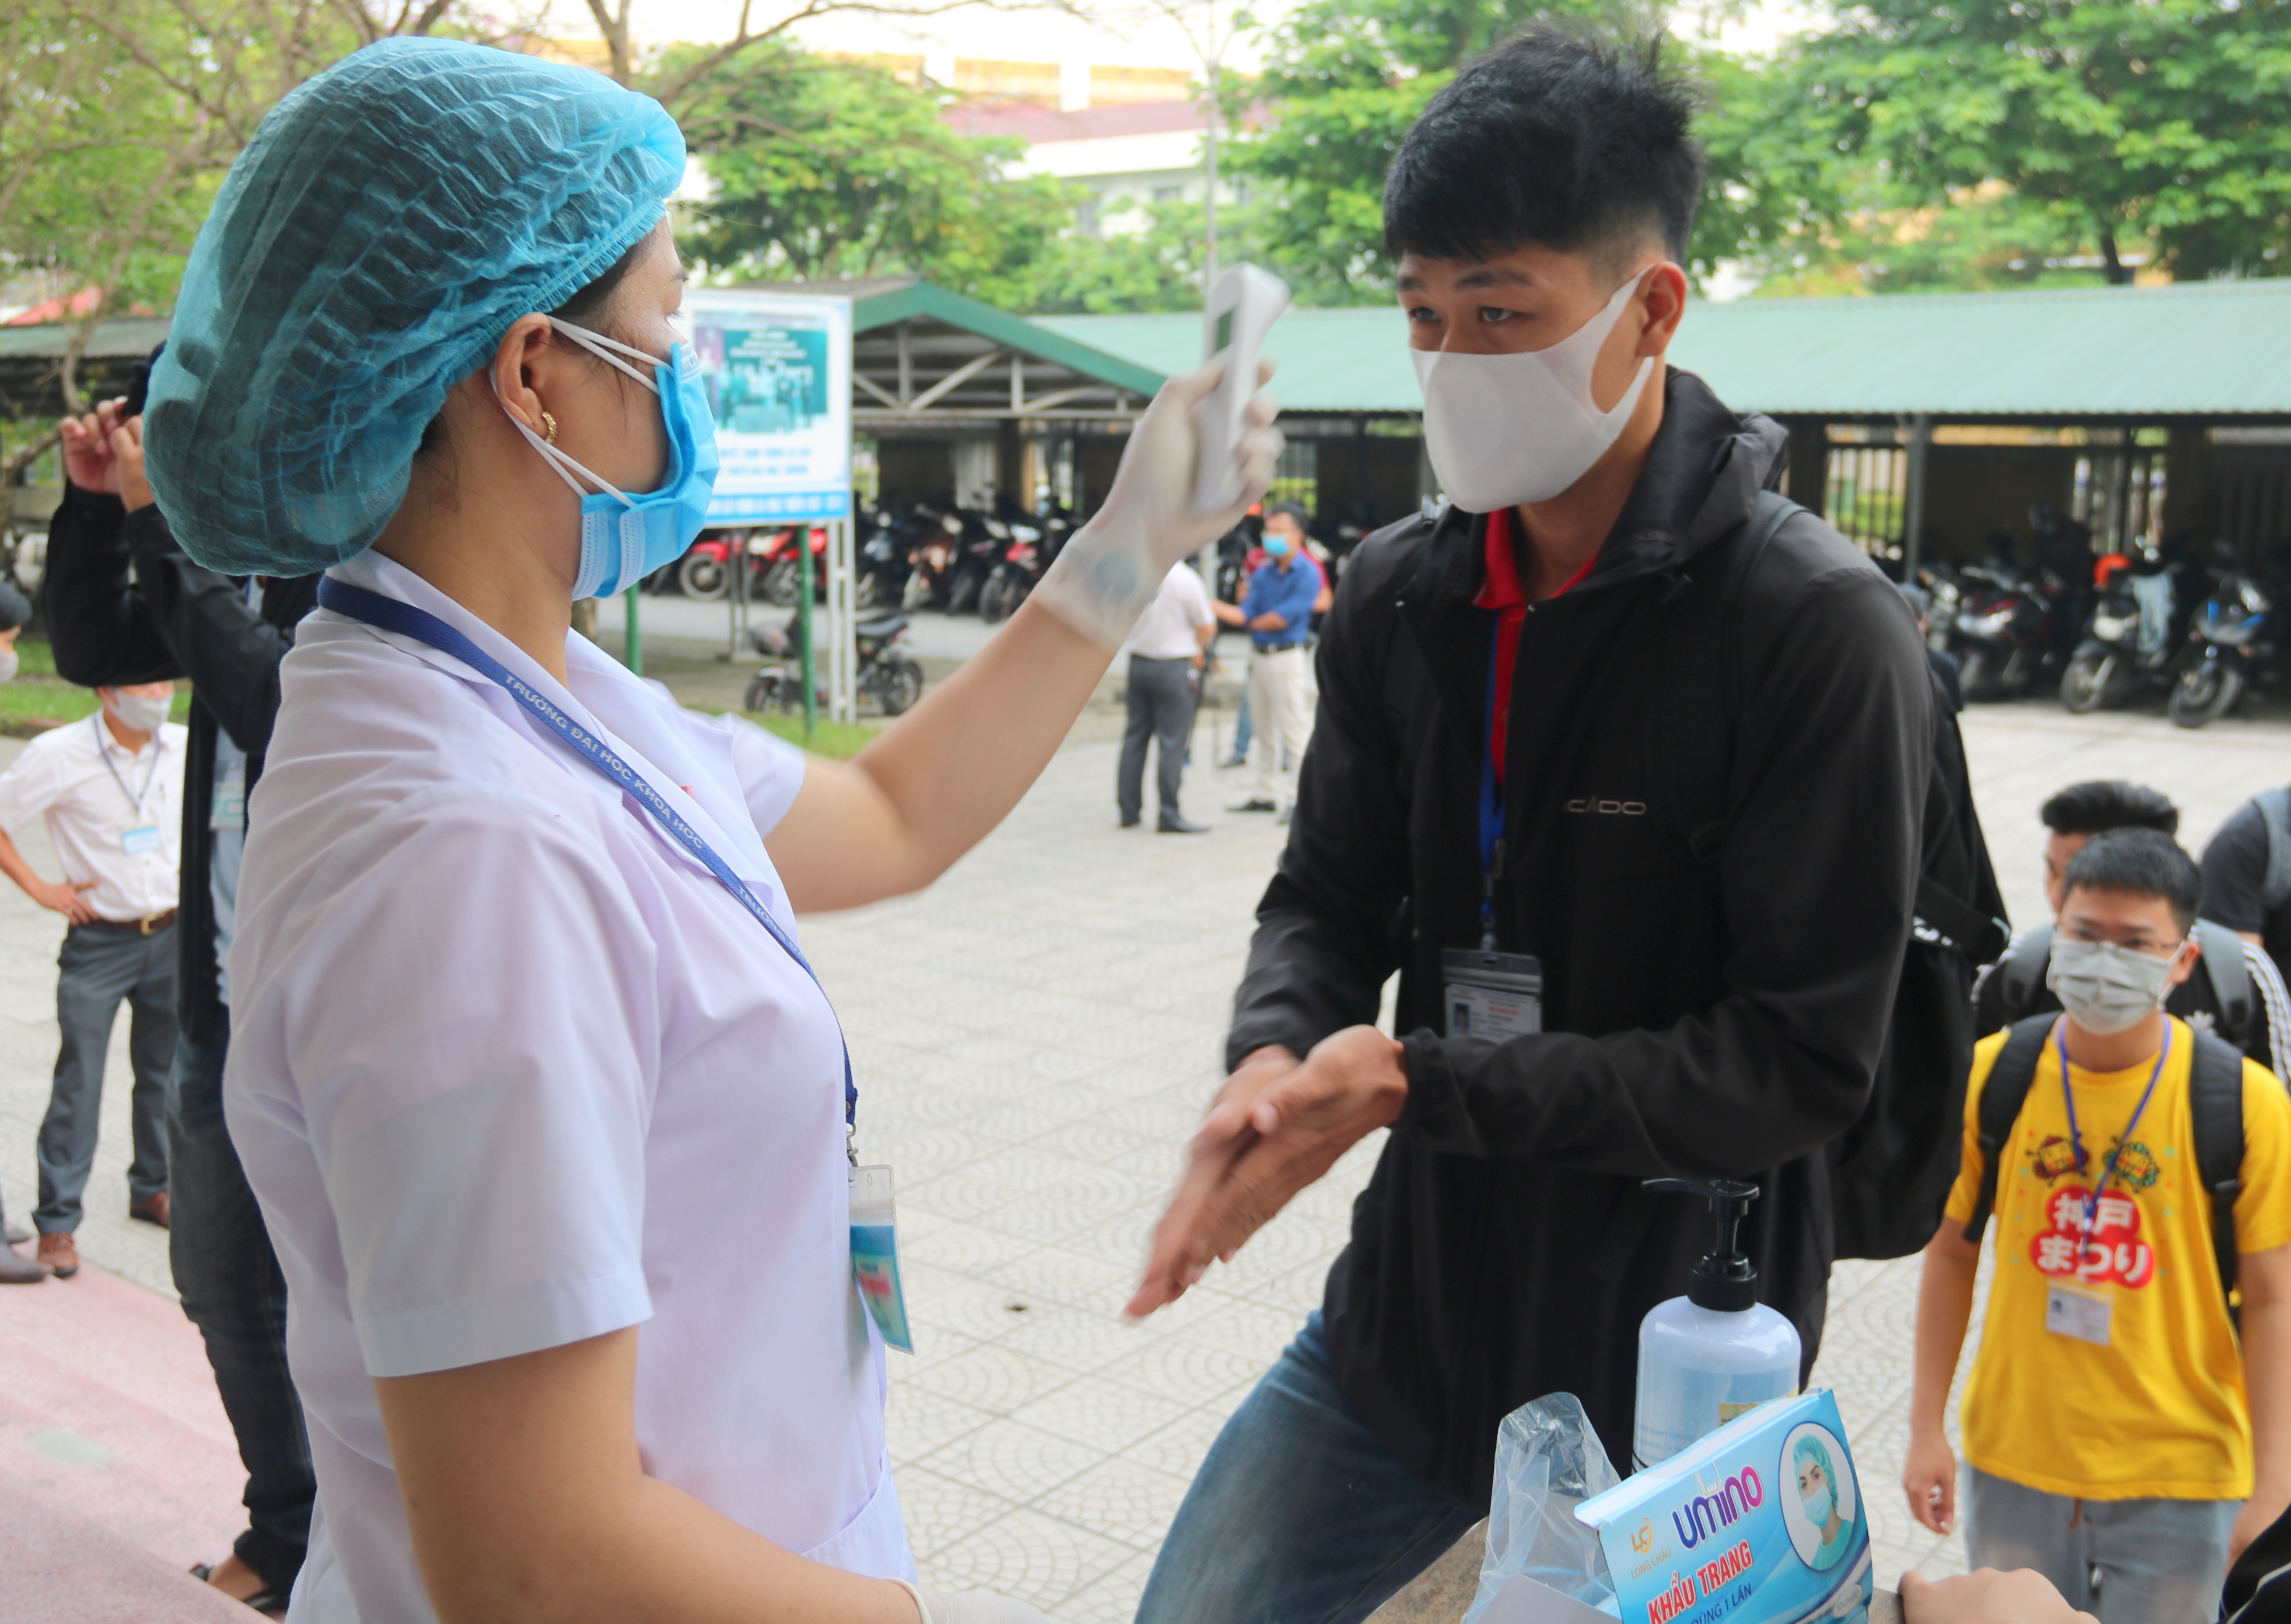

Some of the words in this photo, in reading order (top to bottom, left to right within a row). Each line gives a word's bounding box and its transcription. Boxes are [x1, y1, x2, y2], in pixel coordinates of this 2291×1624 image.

[635, 779, 671, 820] KHOA
[2036, 1235, 2148, 1283] まつり
[1631, 1560, 1651, 1579] LONG
[1647, 1571, 1696, 1624] KHẨU
[1696, 1539, 1753, 1597] TRANG
[1724, 1598, 1729, 1611] 1
